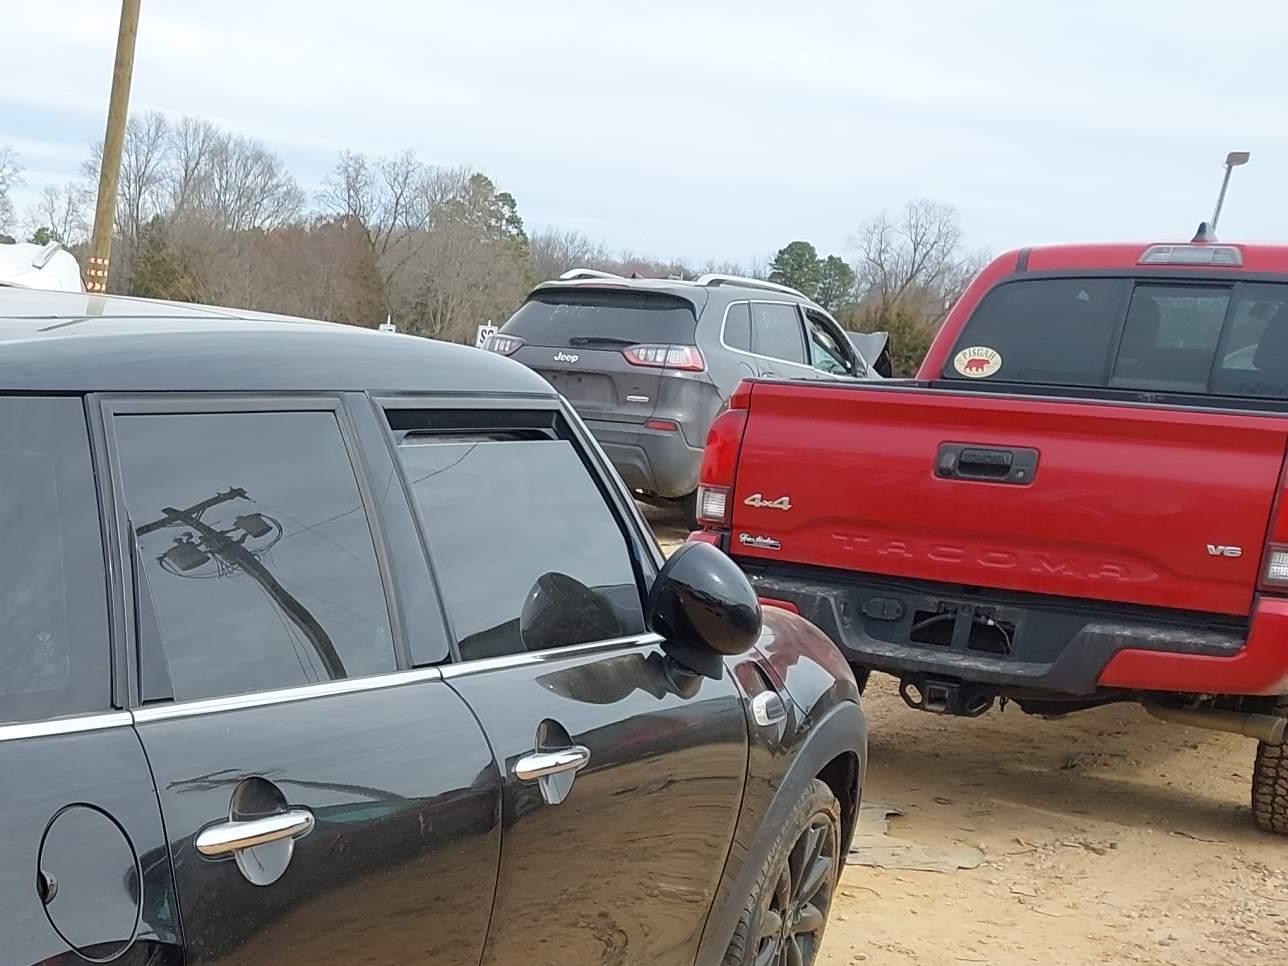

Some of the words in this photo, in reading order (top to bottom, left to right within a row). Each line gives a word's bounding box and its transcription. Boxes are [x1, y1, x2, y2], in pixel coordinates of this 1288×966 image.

[553, 351, 579, 364] Jeep
[831, 532, 1132, 582] TACOMA
[1206, 544, 1242, 558] V6
